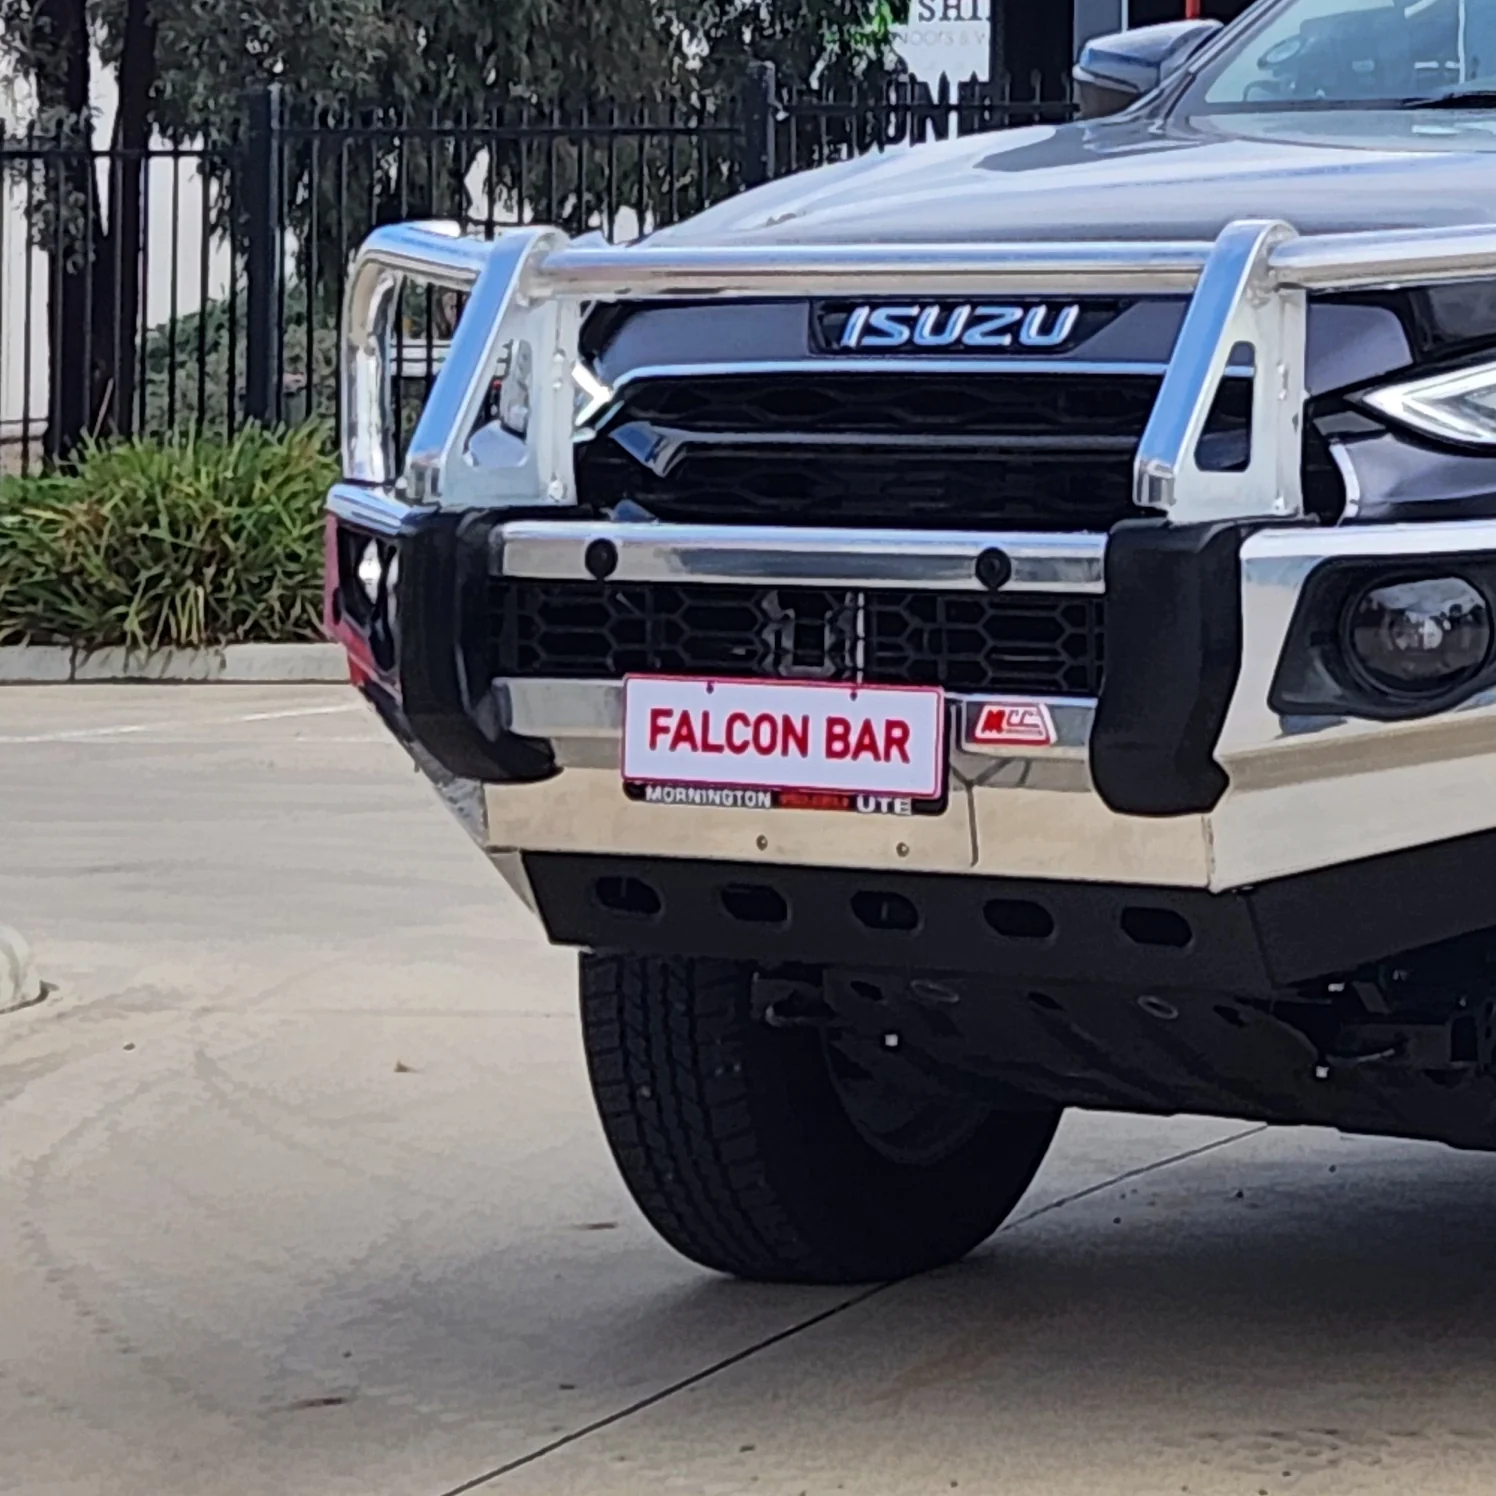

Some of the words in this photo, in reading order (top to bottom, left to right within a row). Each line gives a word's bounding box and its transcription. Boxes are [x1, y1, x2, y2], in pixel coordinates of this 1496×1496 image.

[840, 303, 1080, 348] ISUZU
[648, 708, 810, 759] FALCON
[825, 716, 911, 764] BAR
[645, 785, 771, 808] MORNINGTON
[856, 794, 911, 816] UTE
